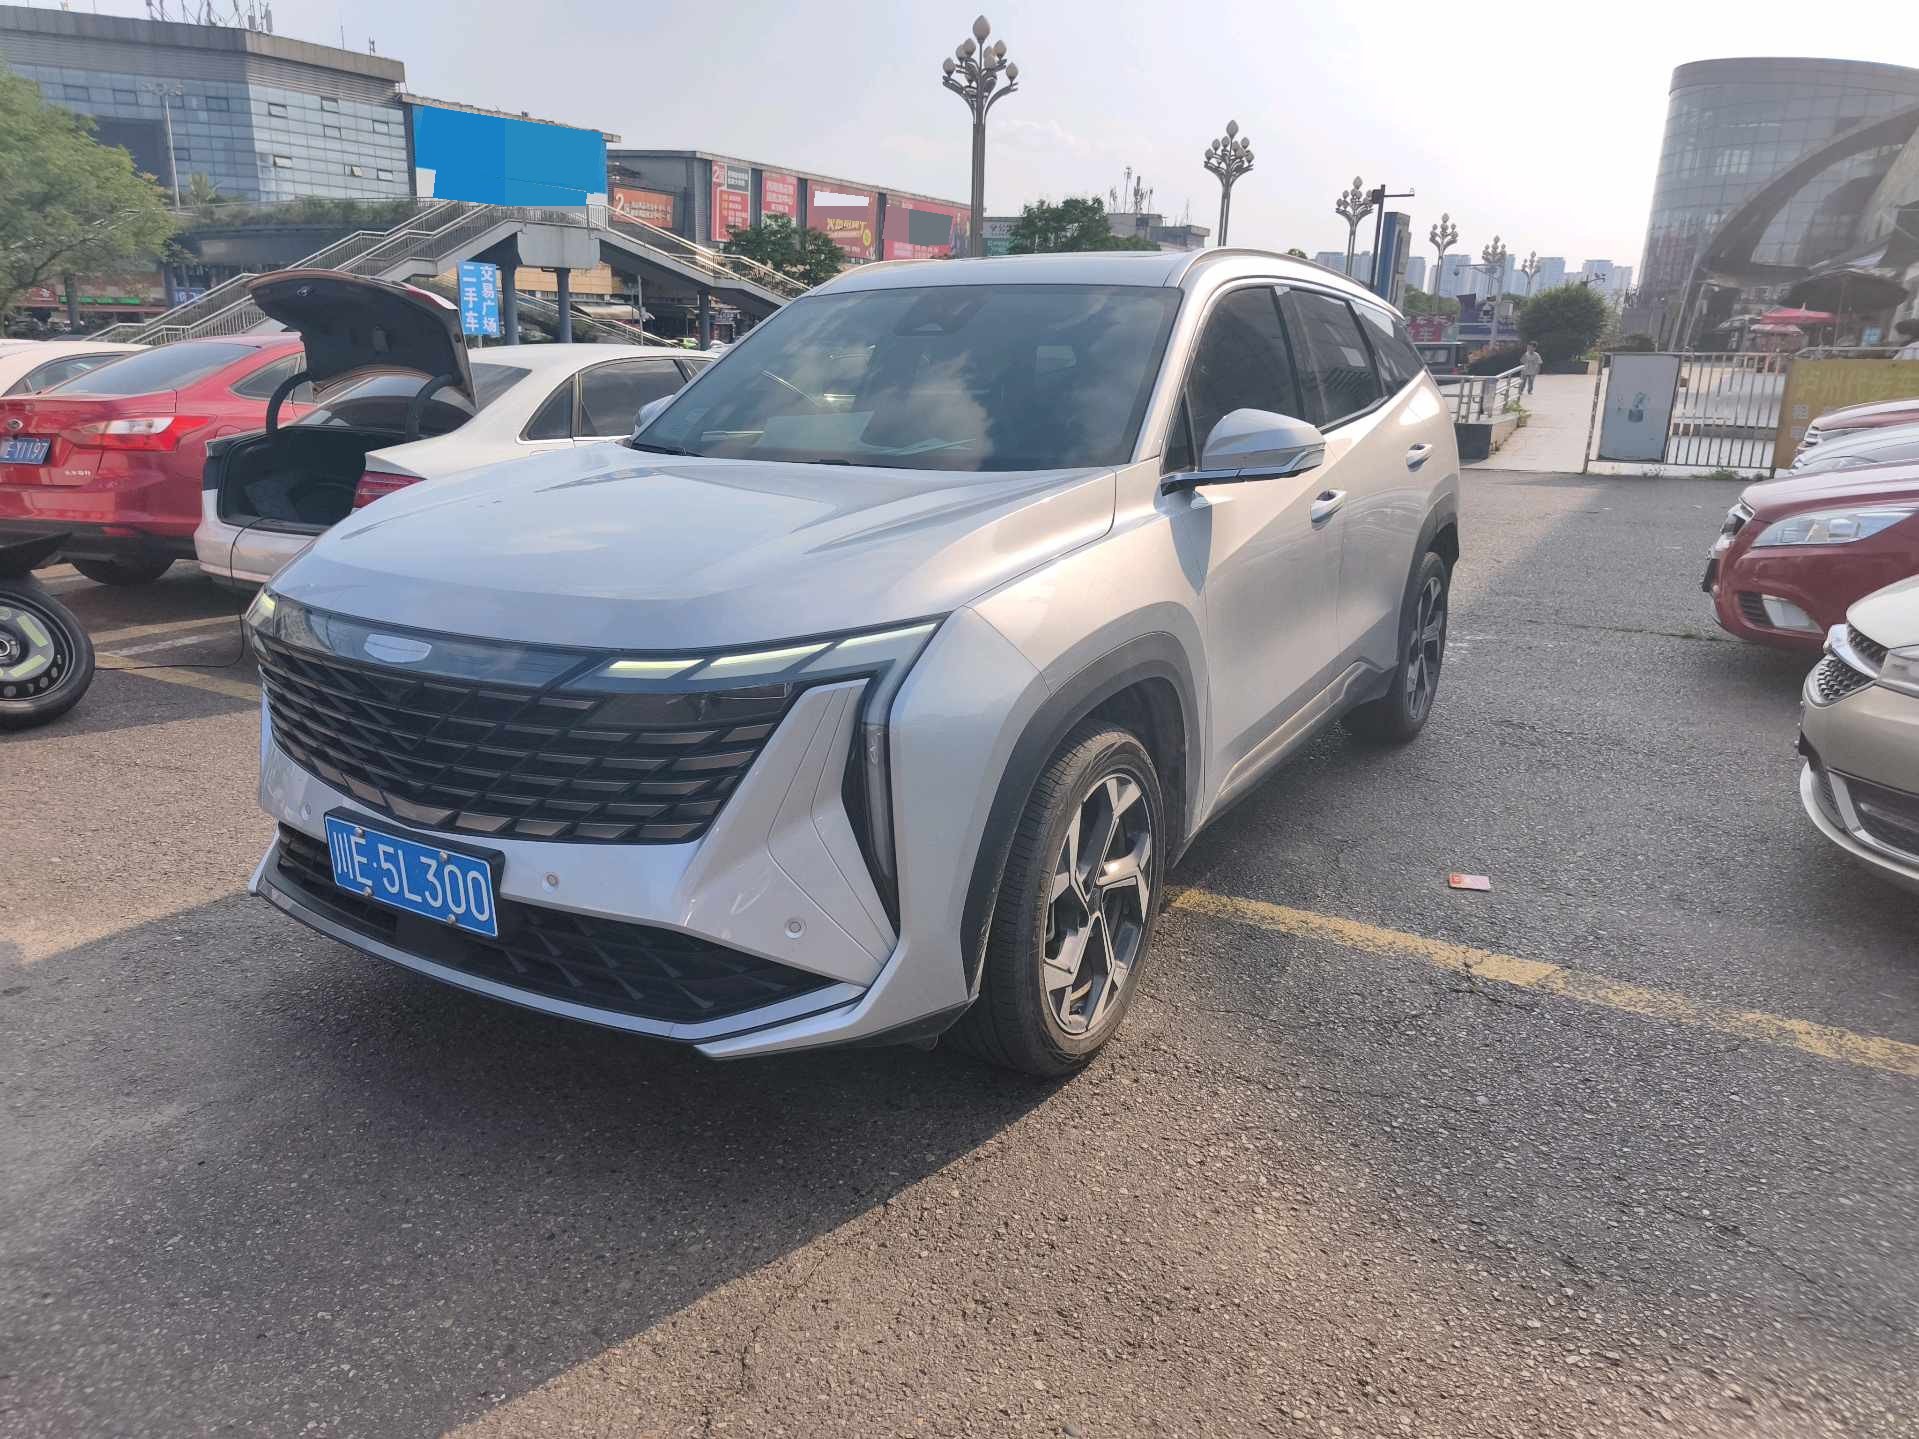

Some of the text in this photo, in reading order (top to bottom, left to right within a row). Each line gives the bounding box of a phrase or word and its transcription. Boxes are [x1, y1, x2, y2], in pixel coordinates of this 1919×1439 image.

[462, 265, 479, 332] 二手车
[480, 265, 497, 333] 交易广场
